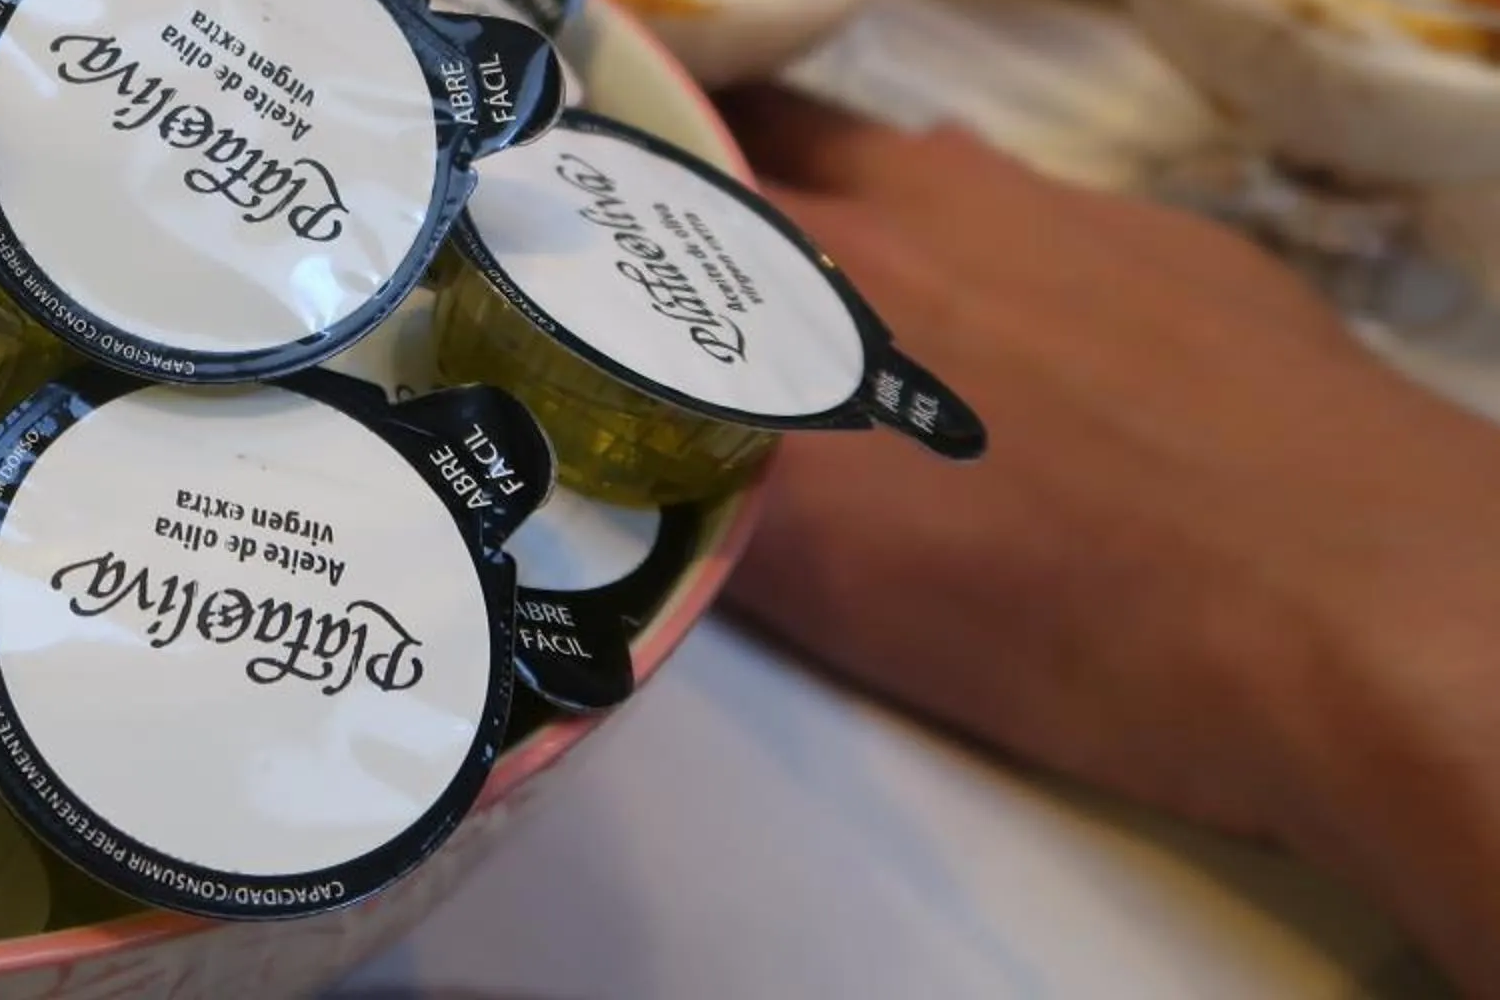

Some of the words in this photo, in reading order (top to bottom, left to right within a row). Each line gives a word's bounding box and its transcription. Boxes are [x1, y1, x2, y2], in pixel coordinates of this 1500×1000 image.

[160, 24, 213, 69] oliva
[190, 9, 246, 57] extra
[213, 64, 244, 92] de
[247, 51, 315, 107] virgen
[440, 61, 479, 125] ABRE
[479, 52, 517, 123] FÁCIL
[50, 33, 351, 242] Plataoliva
[243, 85, 313, 142] Aceite
[652, 202, 690, 239] oliva
[702, 262, 748, 314] Aceite
[716, 253, 765, 306] virgen
[429, 445, 493, 510] ABRE
[463, 423, 525, 496] FÁCIL
[175, 488, 245, 521] extra
[251, 506, 335, 547] virgen
[154, 516, 219, 551] oliva
[226, 534, 257, 563] de
[262, 542, 346, 587] Aceite
[51, 548, 424, 696] Plataoliva
[516, 601, 576, 626] ABRE
[519, 629, 593, 659] FÁCIL
